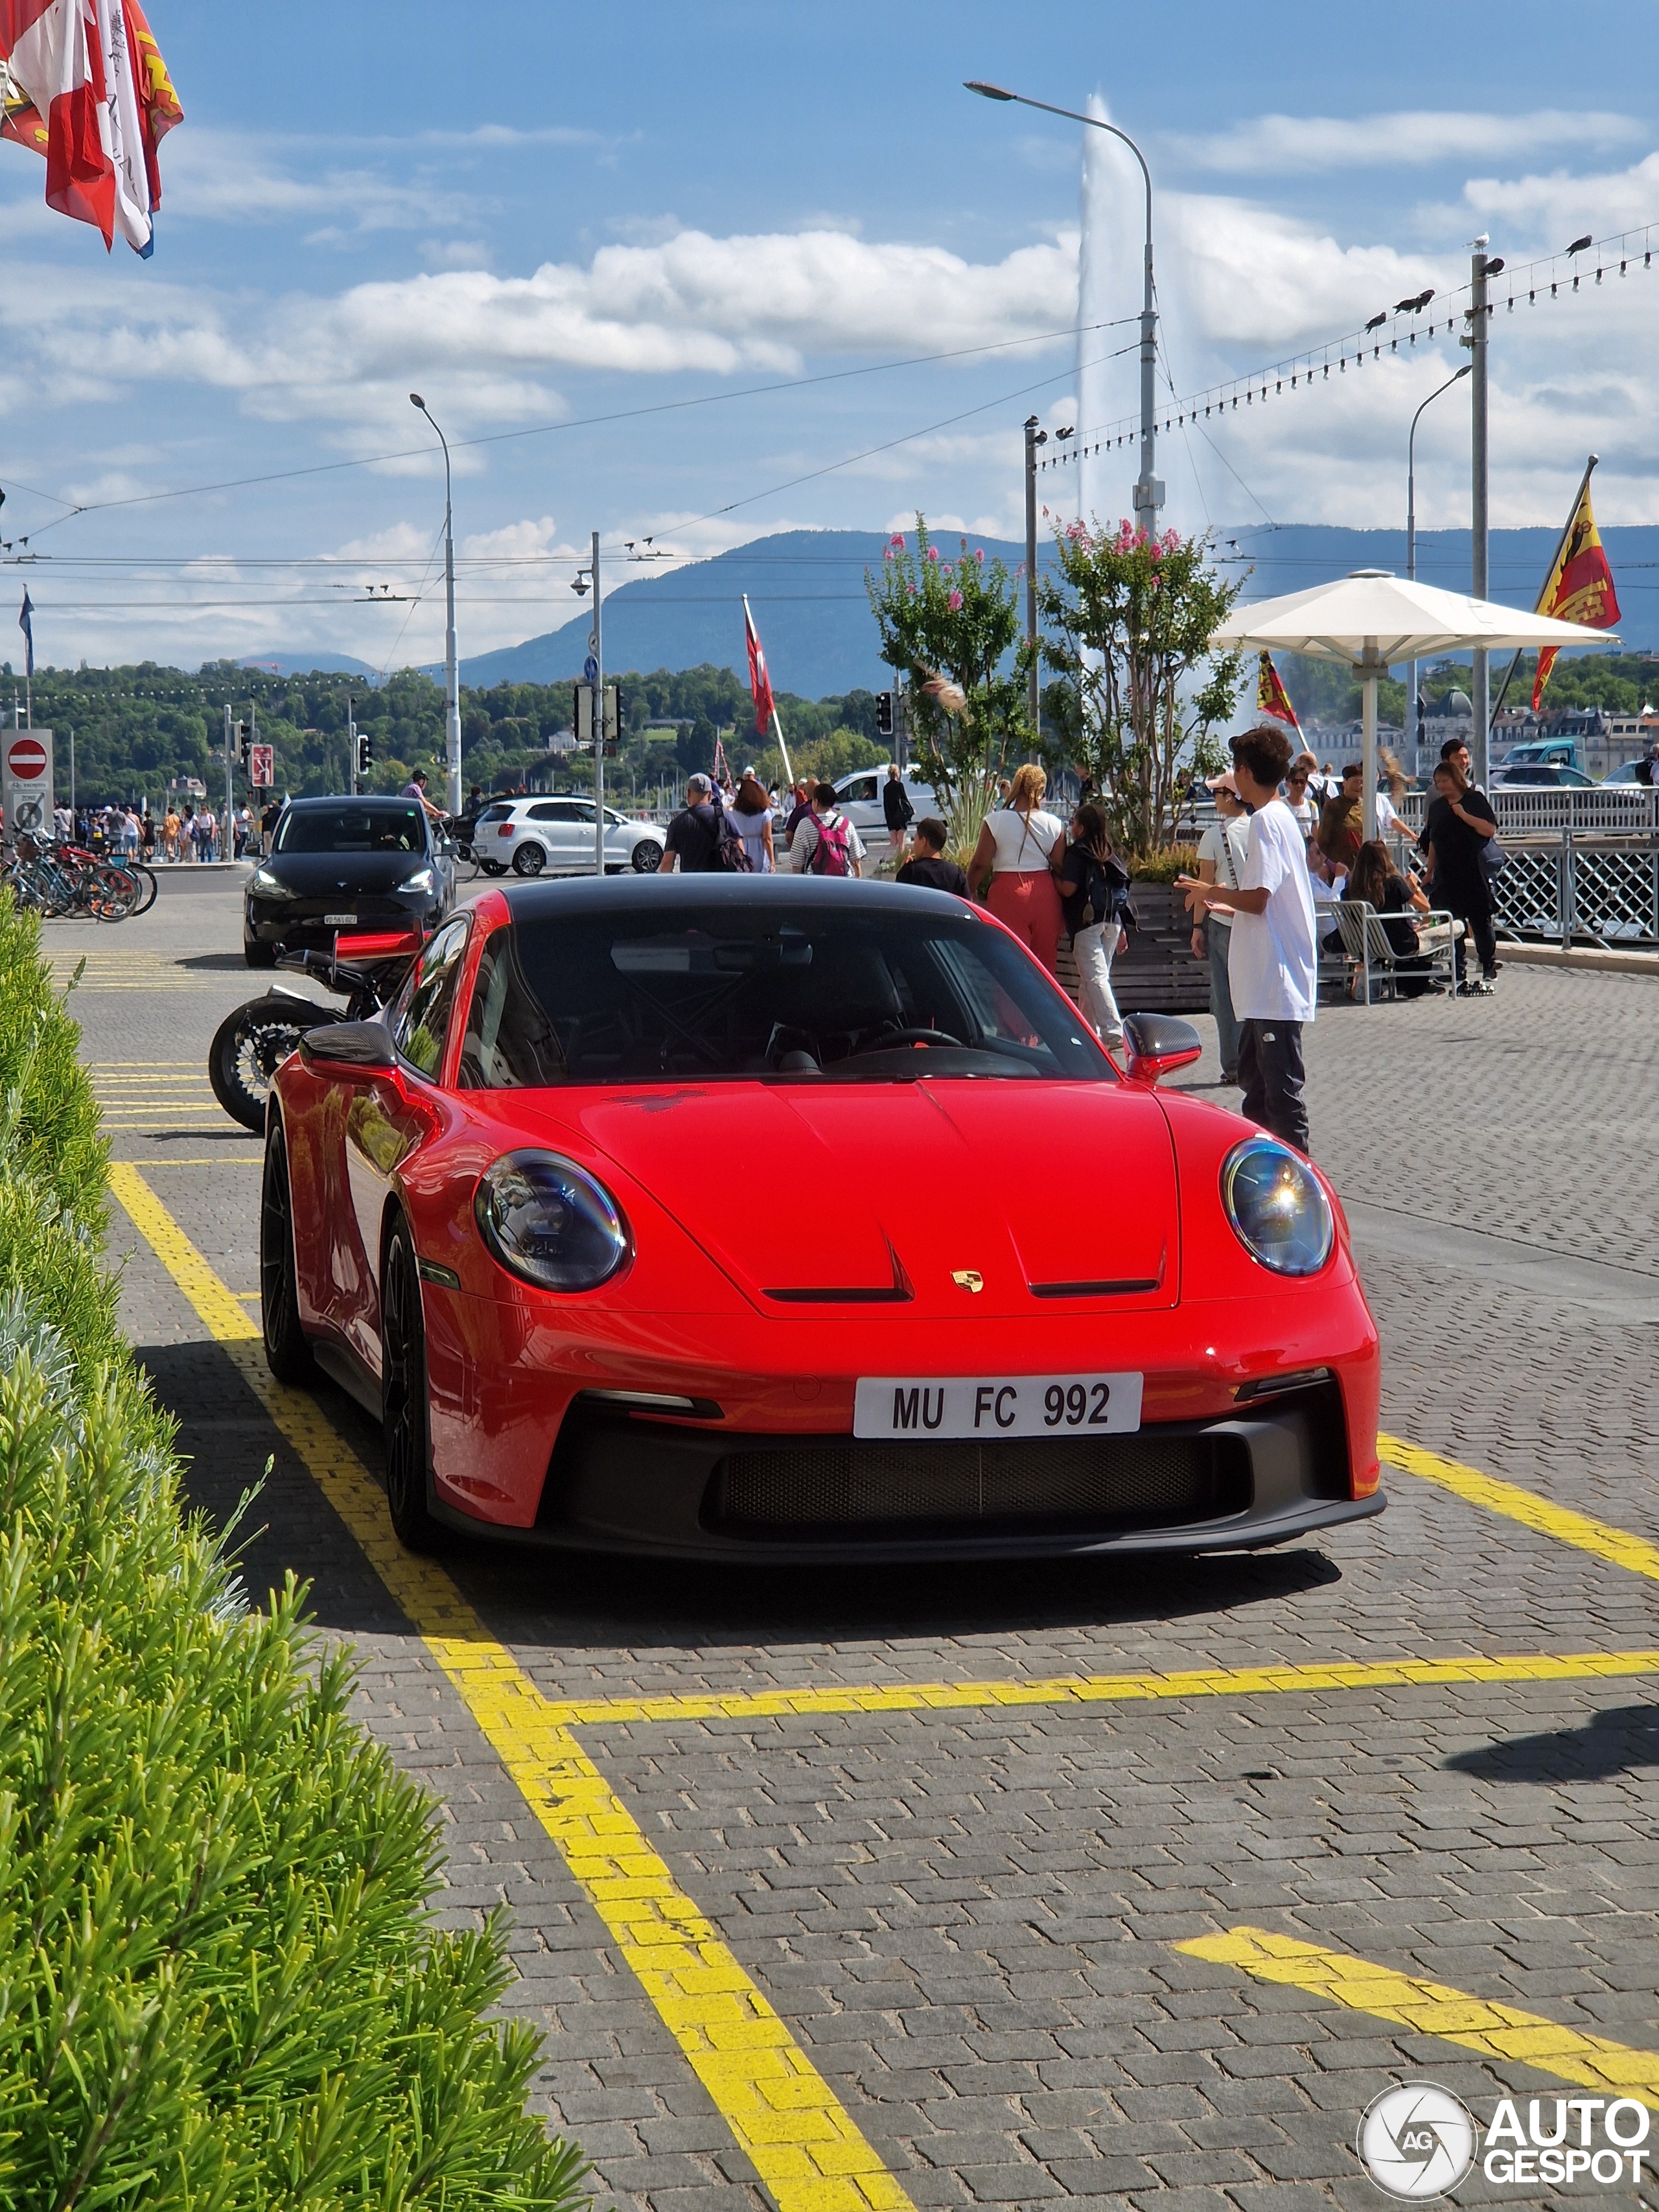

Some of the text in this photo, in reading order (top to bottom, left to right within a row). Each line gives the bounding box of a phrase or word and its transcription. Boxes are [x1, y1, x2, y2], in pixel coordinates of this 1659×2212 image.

[893, 1383, 1110, 1428] MU FC 992
